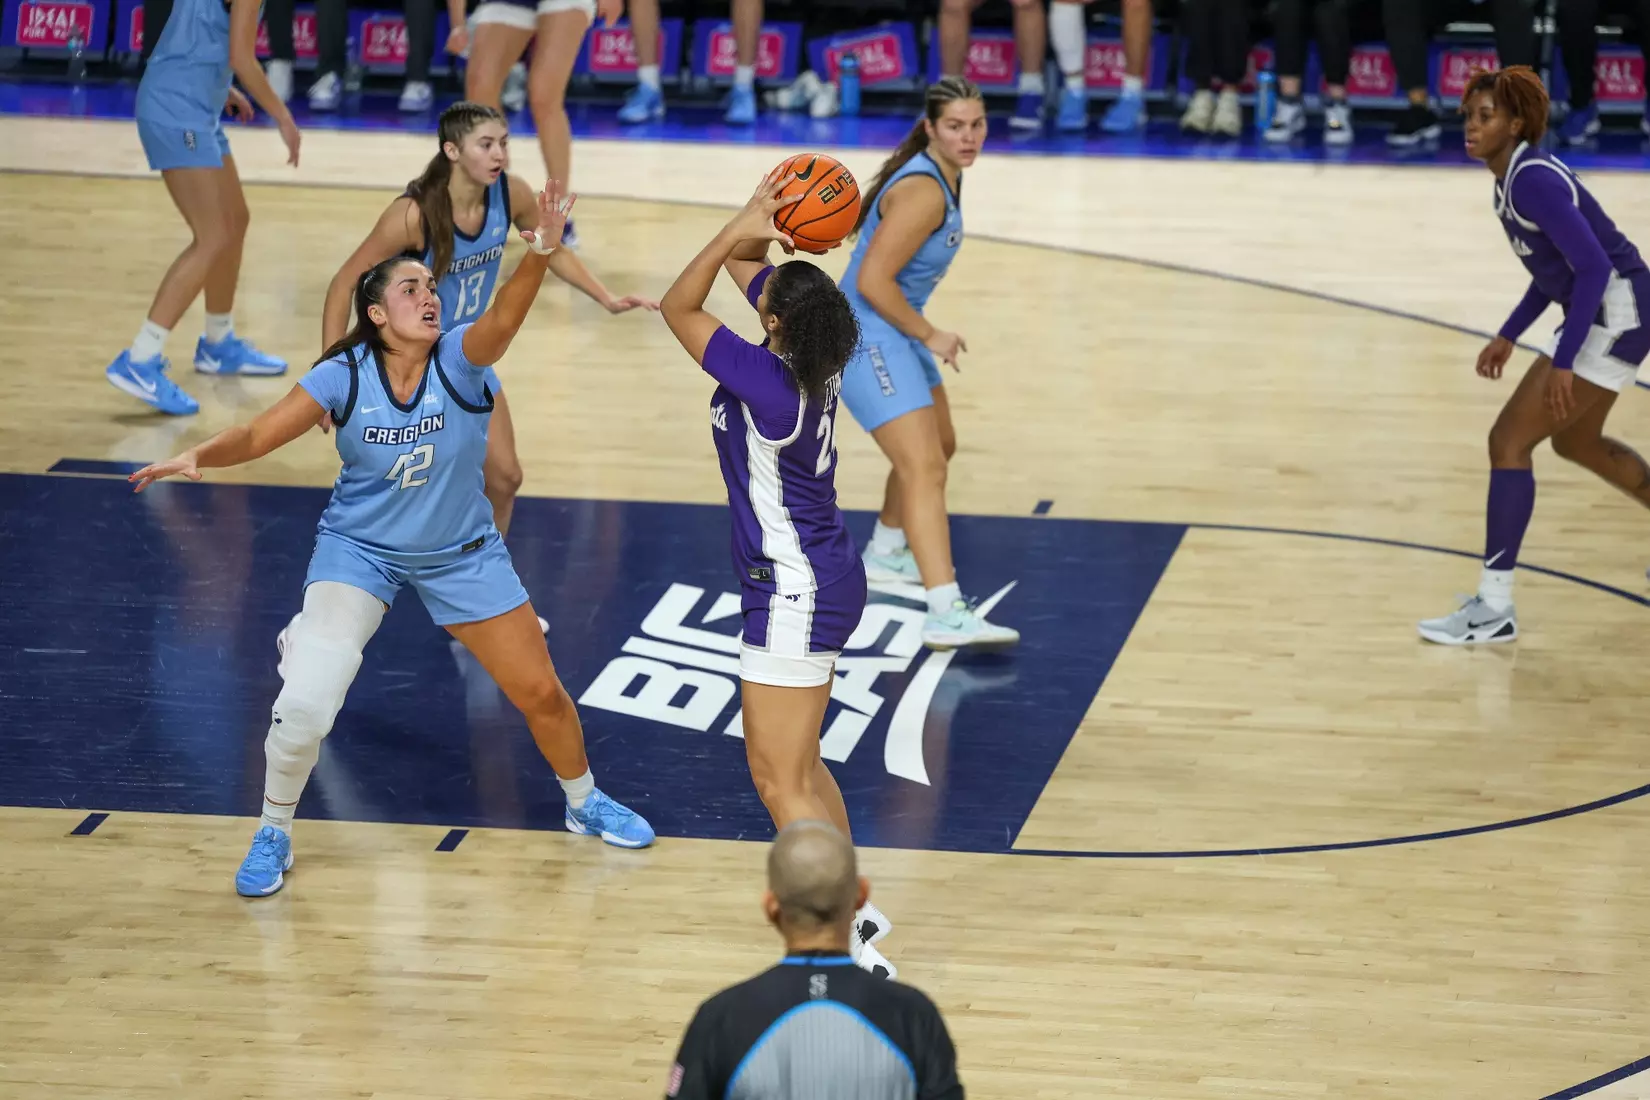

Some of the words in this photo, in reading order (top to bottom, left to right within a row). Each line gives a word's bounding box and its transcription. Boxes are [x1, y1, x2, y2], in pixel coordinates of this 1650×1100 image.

[817, 170, 854, 205] ELITE
[445, 243, 505, 275] REIGHTON
[454, 270, 487, 321] 13
[363, 413, 444, 445] CREIGHON
[815, 413, 837, 477] 2
[384, 444, 435, 490] 42
[578, 582, 746, 733] BIG
